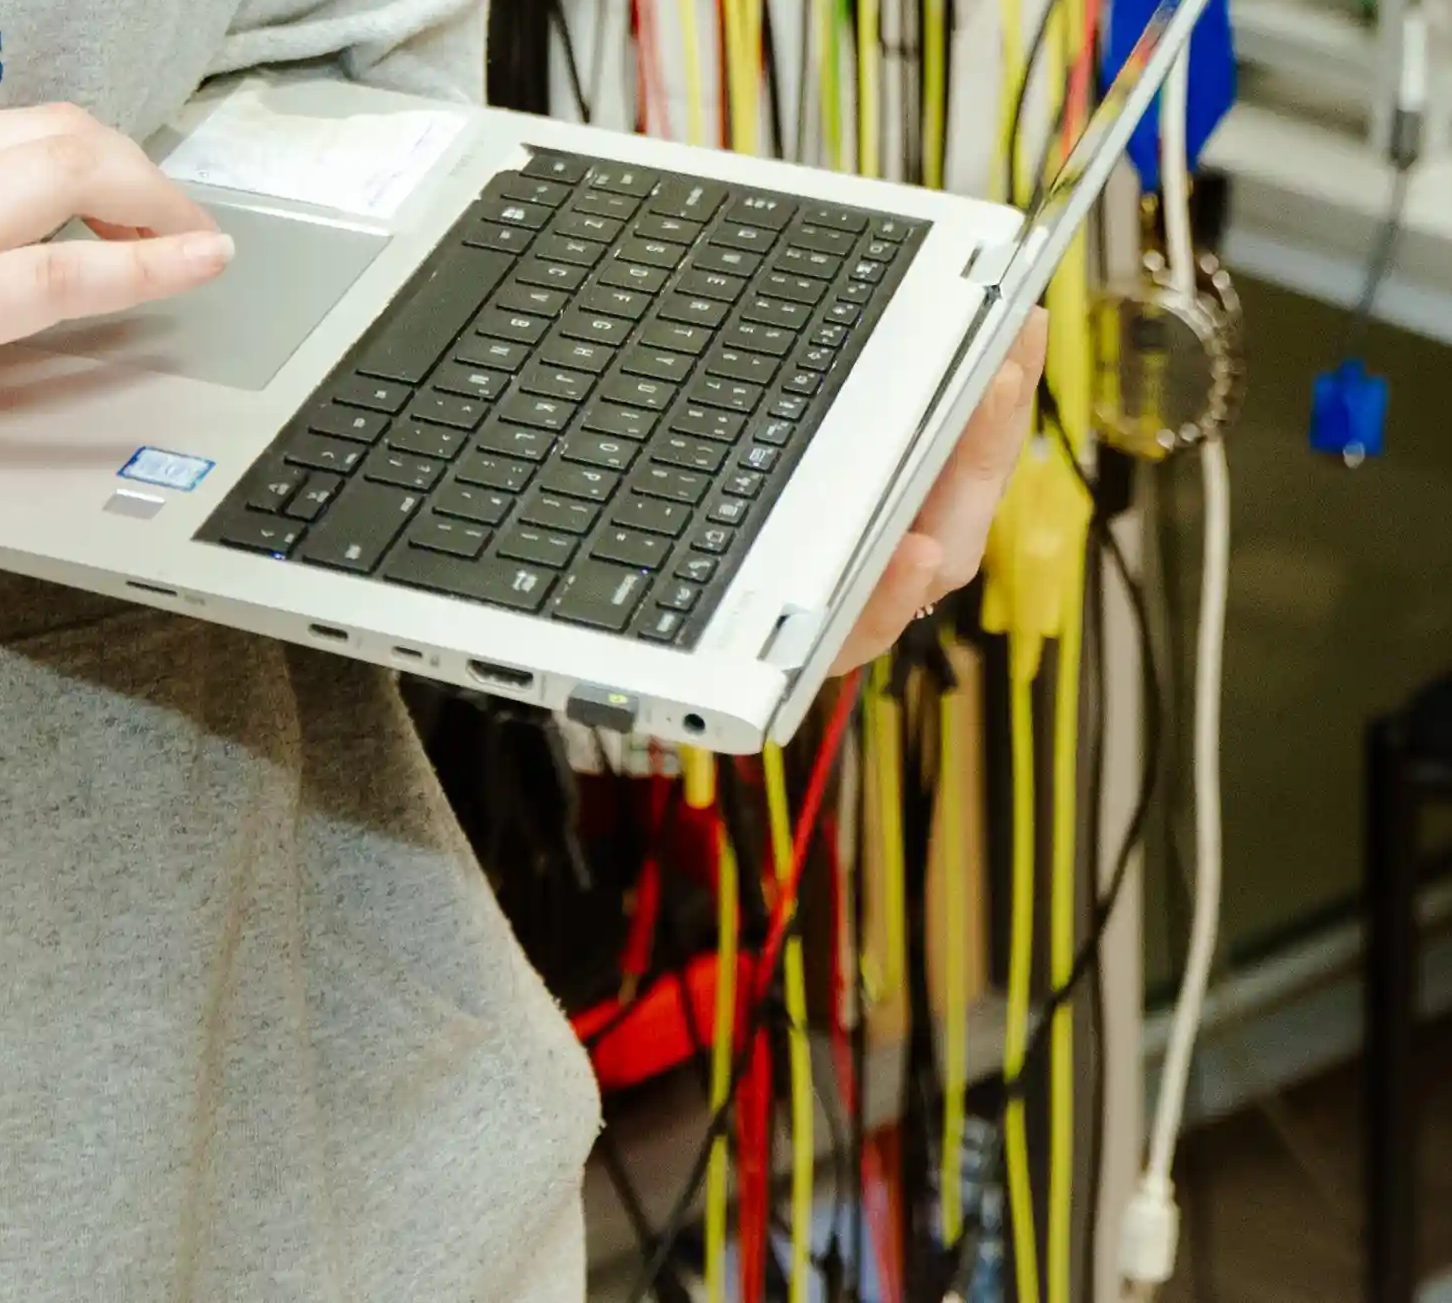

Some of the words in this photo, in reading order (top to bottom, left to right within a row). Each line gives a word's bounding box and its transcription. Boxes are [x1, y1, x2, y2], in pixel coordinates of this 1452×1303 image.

[584, 218, 604, 229] Z
[645, 244, 666, 253] S
[548, 267, 568, 277] C
[629, 267, 649, 277] D
[706, 276, 726, 286] E
[530, 293, 549, 303] V
[613, 293, 632, 303] F
[510, 318, 531, 328] B
[592, 320, 612, 330] G
[673, 329, 693, 338] T
[573, 346, 594, 357] H
[655, 357, 675, 366] Y
[535, 402, 556, 413] K
[514, 432, 536, 440] L
[599, 442, 619, 453] O
[582, 471, 602, 482] P
